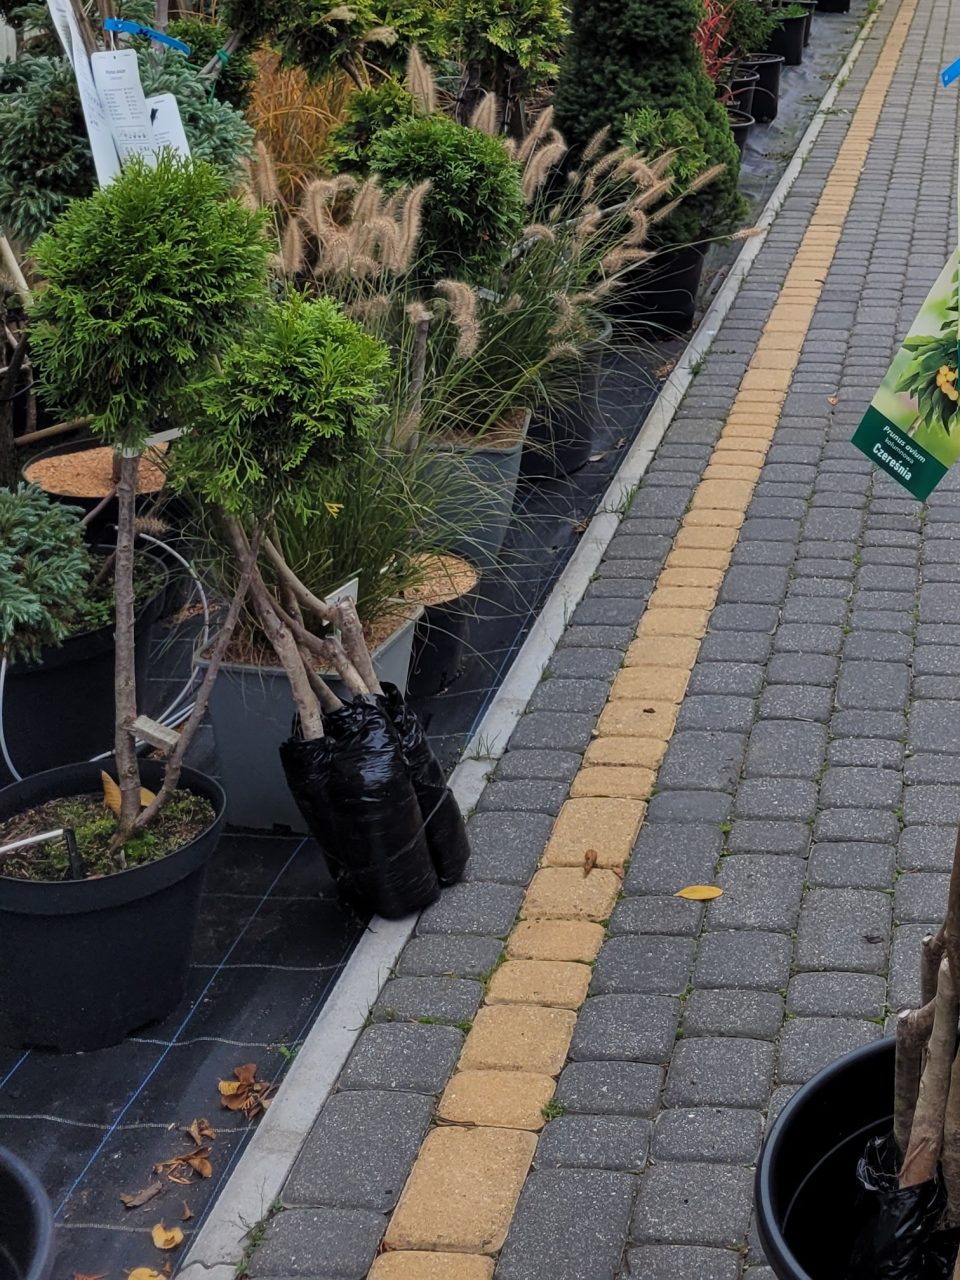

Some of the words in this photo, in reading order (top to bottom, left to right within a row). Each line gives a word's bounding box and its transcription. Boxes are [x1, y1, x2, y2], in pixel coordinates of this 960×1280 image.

[873, 442, 912, 481] Czereśnia
[883, 425, 906, 447] Prunus
[905, 444, 926, 463] avium
[884, 437, 915, 464] kolumnowa
